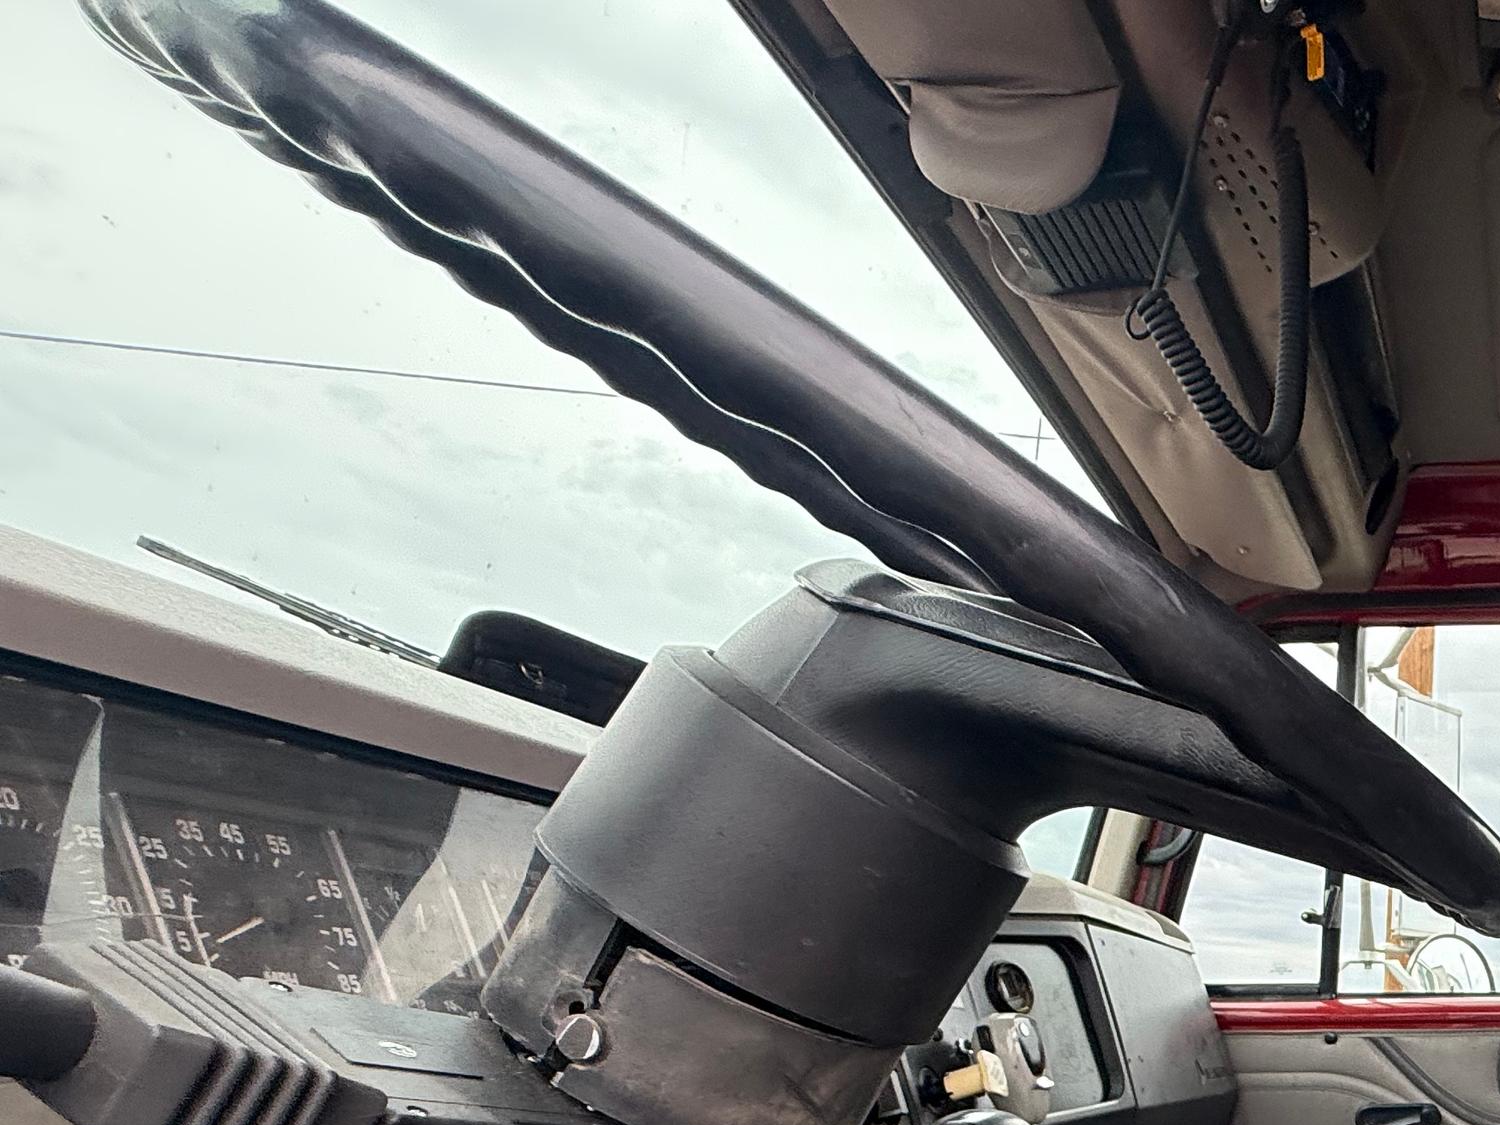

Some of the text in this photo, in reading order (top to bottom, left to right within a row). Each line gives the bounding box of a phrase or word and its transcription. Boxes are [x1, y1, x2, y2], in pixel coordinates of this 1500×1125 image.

[71, 824, 104, 849] 25
[175, 818, 204, 842] 35
[219, 822, 245, 844] 45
[138, 836, 168, 860] 25
[265, 834, 291, 856] 55
[317, 879, 343, 899] 65
[175, 930, 193, 952] 5
[331, 927, 358, 947] 75
[337, 974, 362, 994] 85
